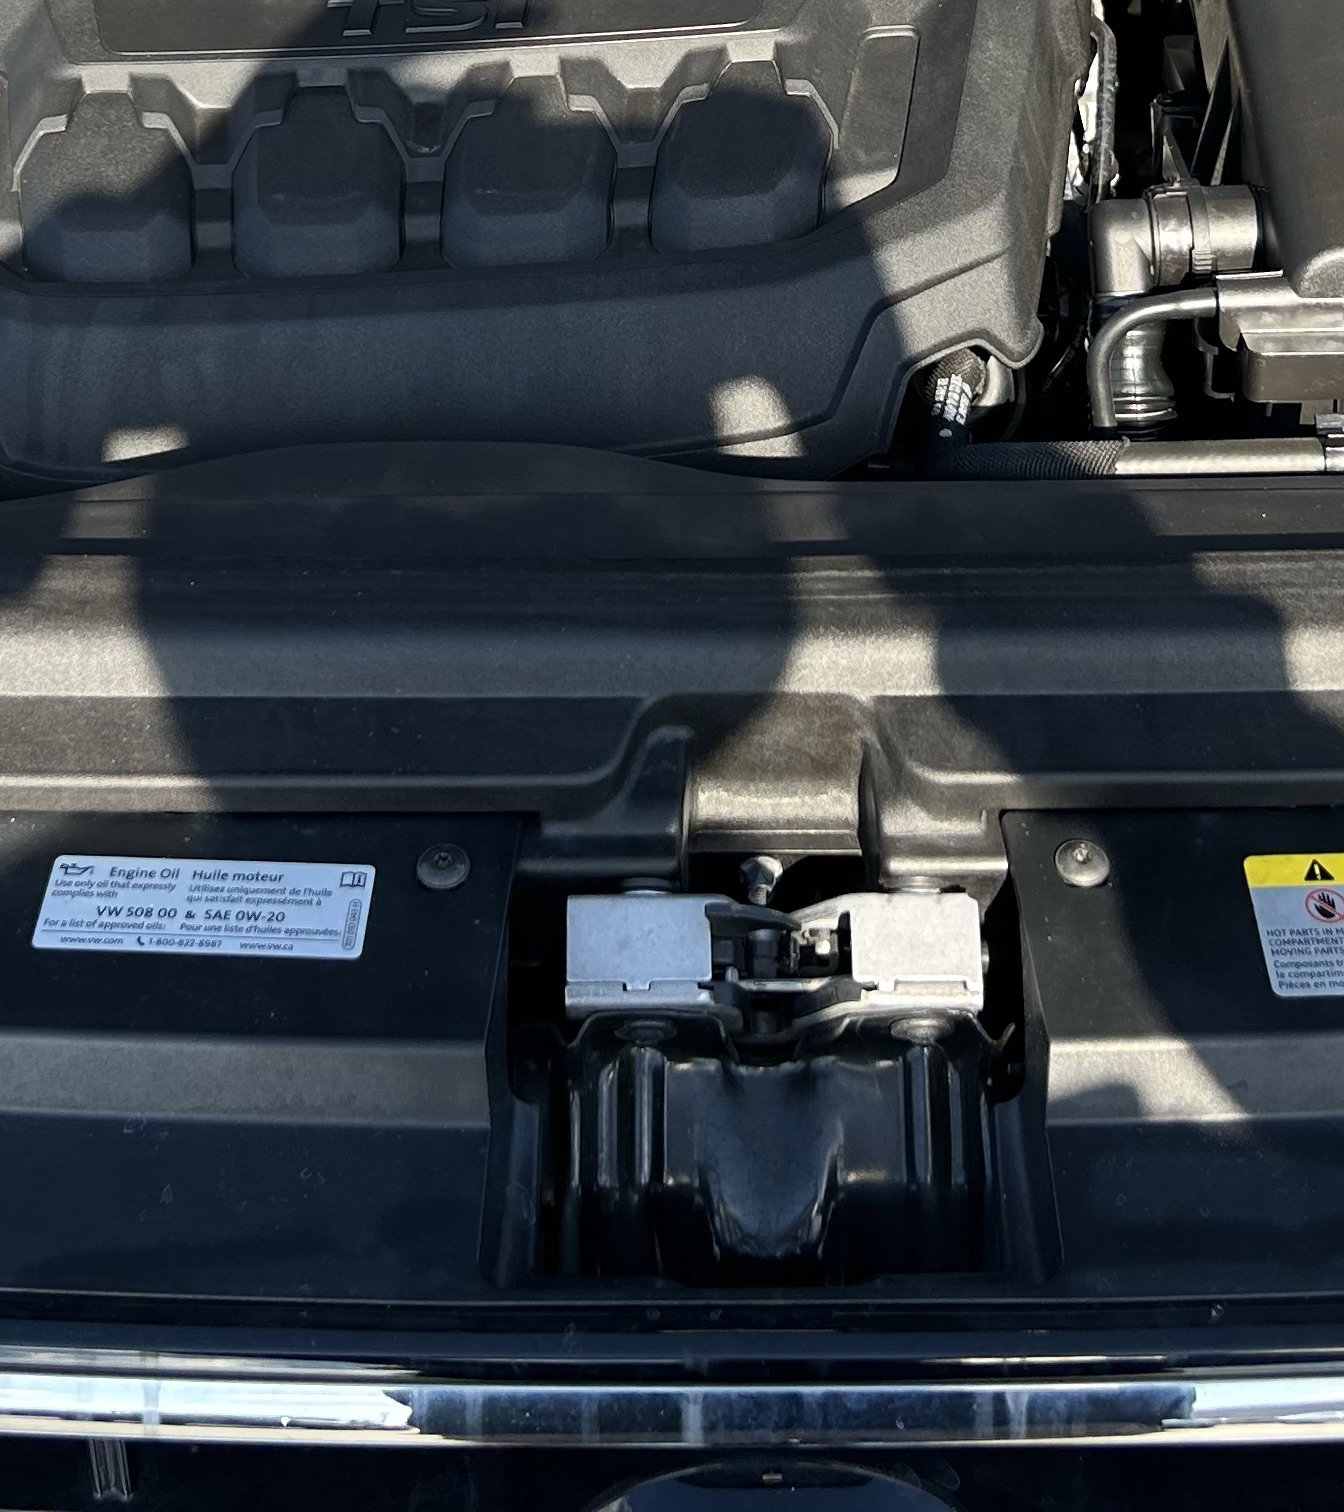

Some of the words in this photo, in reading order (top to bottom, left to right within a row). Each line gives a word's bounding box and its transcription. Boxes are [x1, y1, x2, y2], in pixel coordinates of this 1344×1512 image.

[110, 867, 156, 880] Engine
[160, 868, 180, 879] Oil
[192, 870, 229, 881] Huile
[232, 872, 284, 883] moteur
[55, 879, 73, 887] Use
[75, 880, 95, 889] only
[97, 880, 108, 888] oil
[110, 880, 130, 889] that
[132, 881, 176, 891] expressly
[51, 890, 94, 898] complies
[303, 888, 333, 897] l'huile
[186, 895, 202, 904] qui
[97, 906, 123, 917] VW
[126, 906, 153, 918] 508
[158, 907, 177, 918] 00
[185, 910, 196, 918] &
[204, 909, 232, 921] SAE
[235, 910, 286, 922] 0W-20
[43, 918, 59, 926] For
[69, 918, 84, 927] list
[86, 919, 98, 928] of
[98, 920, 144, 932] approved
[179, 922, 202, 931] Pour
[204, 924, 222, 932] une
[224, 923, 243, 933] liste
[245, 924, 283, 934] d'huiles
[1267, 929, 1287, 937] HOT
[1289, 928, 1321, 937] PARTS
[60, 936, 124, 944] www.vw.com
[240, 941, 294, 951] www.vw.ca
[1271, 947, 1312, 956] MOVING
[1274, 958, 1334, 970] Composants
[1278, 980, 1311, 989] Pièces
